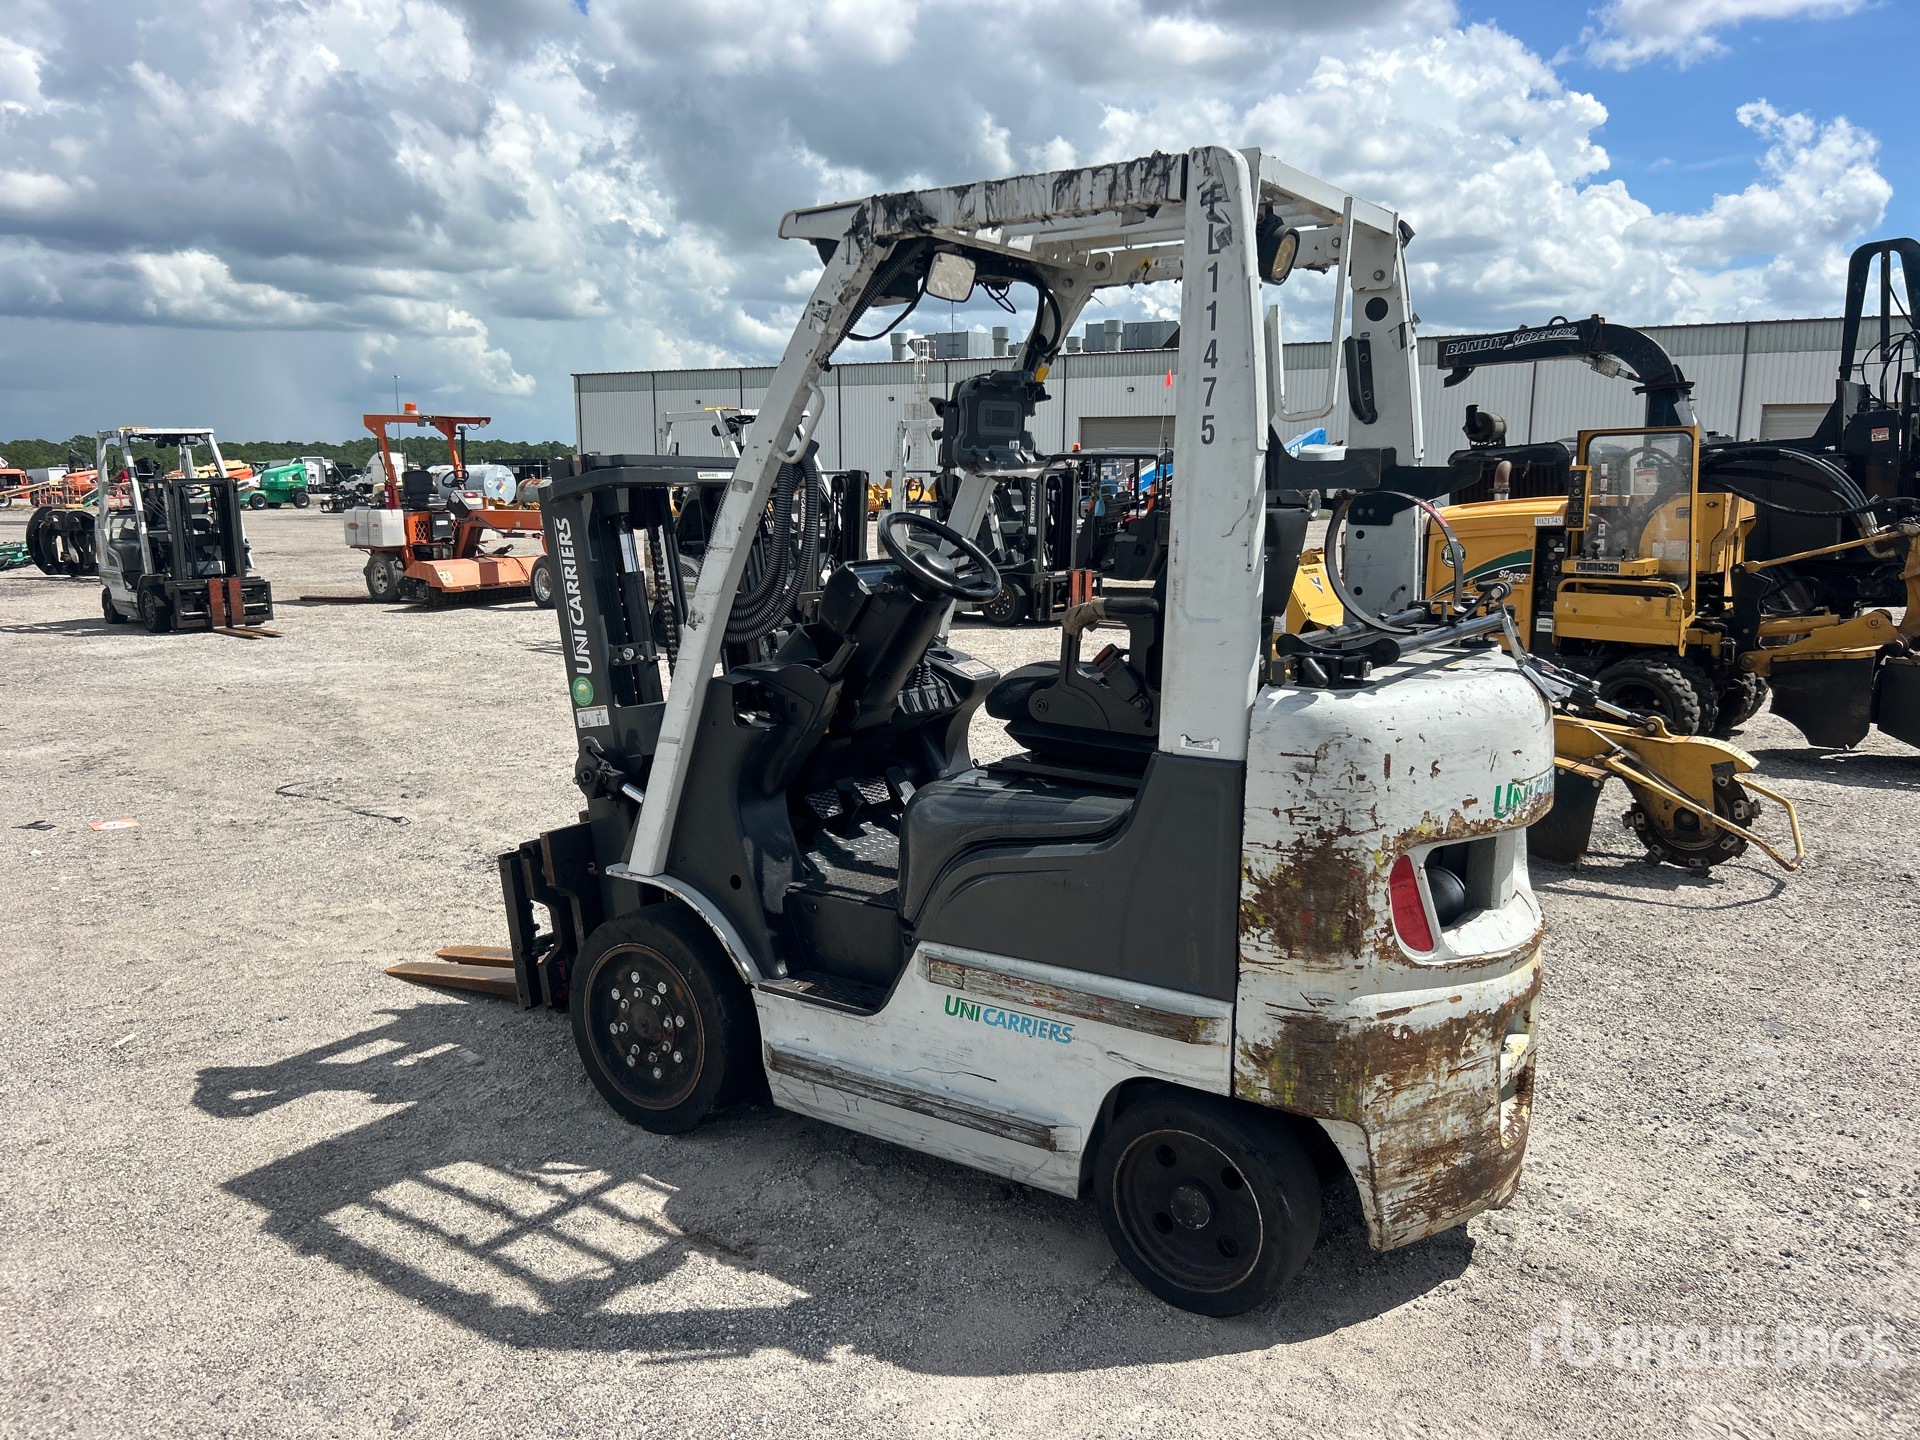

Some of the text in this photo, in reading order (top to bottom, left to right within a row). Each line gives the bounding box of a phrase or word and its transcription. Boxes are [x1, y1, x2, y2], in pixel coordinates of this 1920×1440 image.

[1445, 335, 1507, 356] BANDIT
[1536, 516, 1562, 525] 1021745
[552, 517, 593, 674] UNICARRIERS
[944, 994, 1076, 1044] UNICARRIERS
